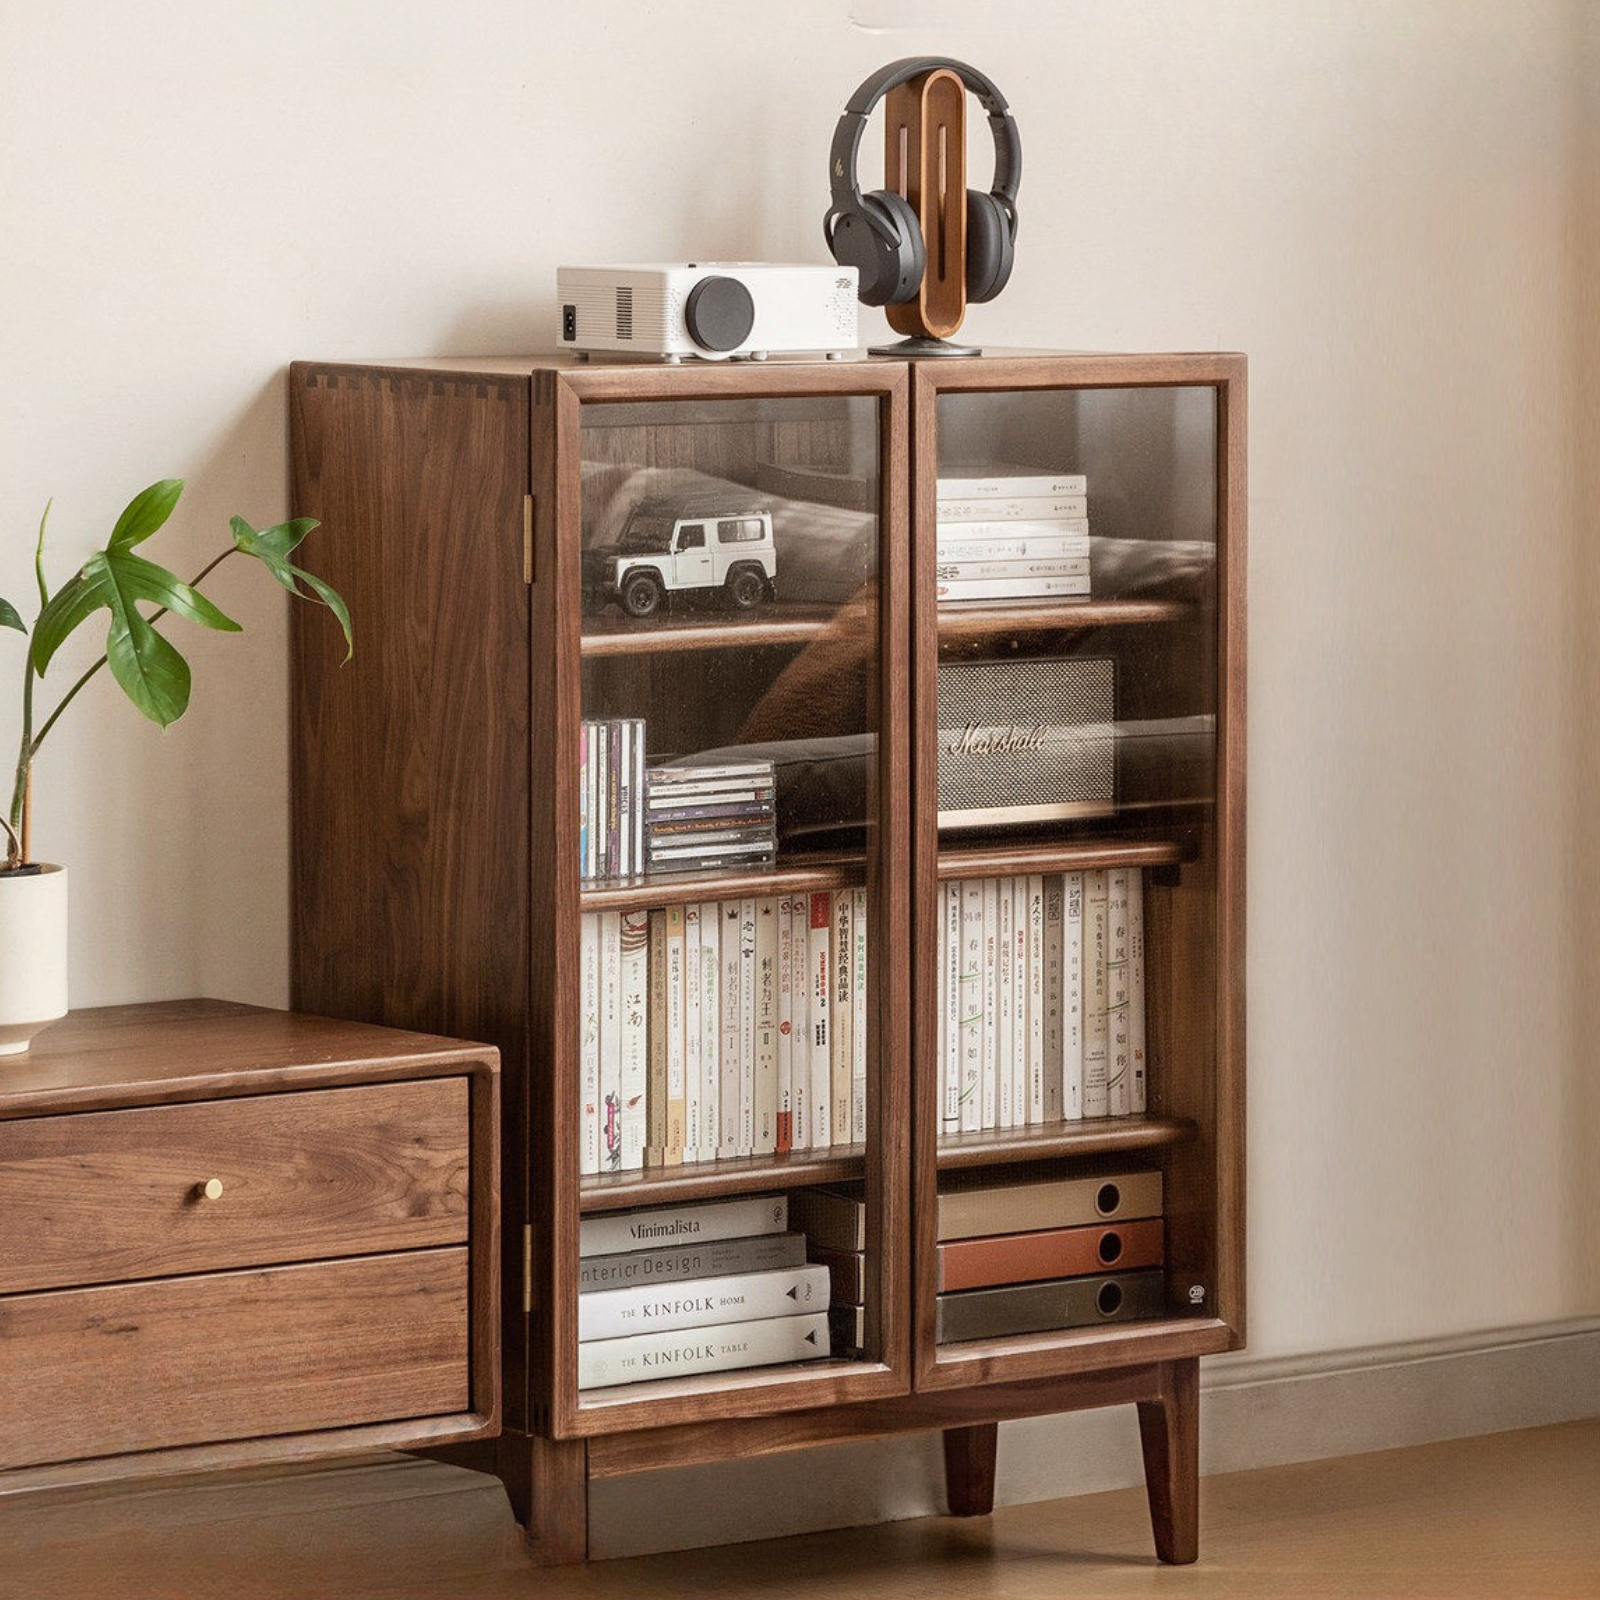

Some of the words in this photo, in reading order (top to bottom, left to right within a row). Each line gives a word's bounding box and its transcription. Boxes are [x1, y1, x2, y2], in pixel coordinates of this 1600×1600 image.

[949, 721, 1050, 754] Marshall
[621, 786, 630, 815] VOICES
[837, 902, 849, 1003] 中华智慧经典品读
[626, 993, 643, 1027] 江南
[966, 938, 979, 1082] 春风十里不如你
[1114, 925, 1127, 1067] 春风十里不如你
[630, 1220, 700, 1240] Minimalista
[581, 1264, 639, 1282] nterior
[643, 1255, 702, 1275] Design
[642, 1297, 715, 1318] KINFOLK
[719, 1296, 746, 1306] HOME
[642, 1345, 715, 1367] KINFOLK
[720, 1343, 749, 1354] TABLE
